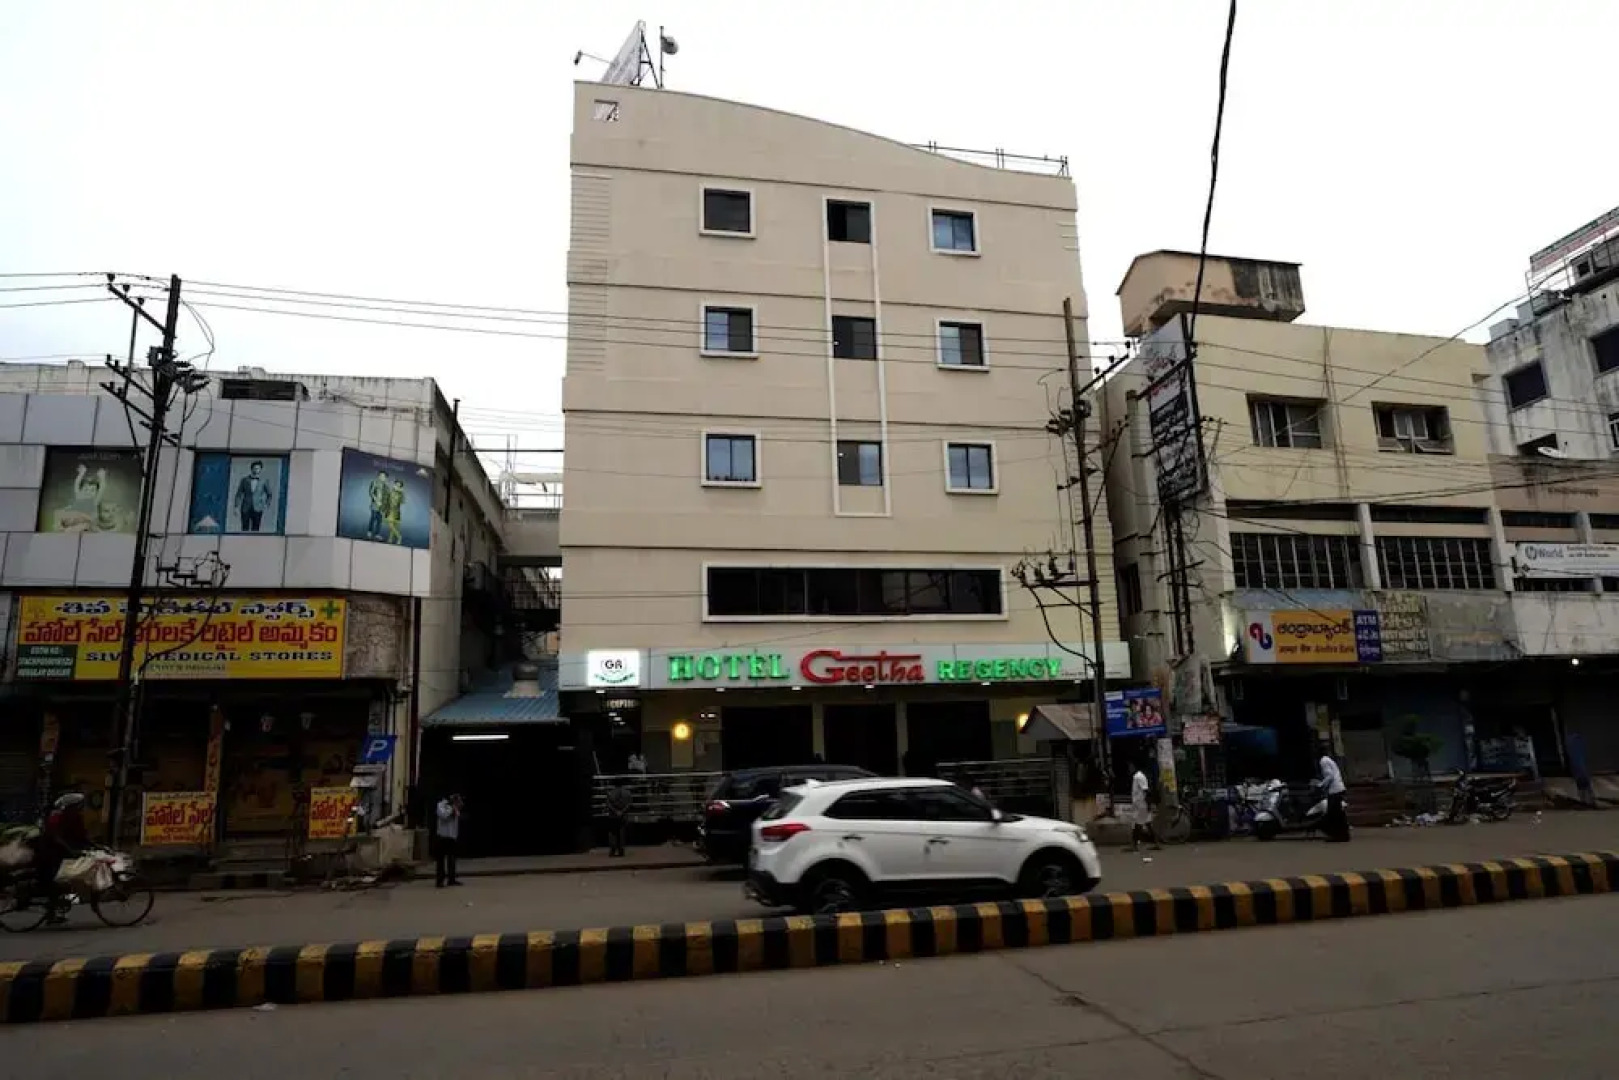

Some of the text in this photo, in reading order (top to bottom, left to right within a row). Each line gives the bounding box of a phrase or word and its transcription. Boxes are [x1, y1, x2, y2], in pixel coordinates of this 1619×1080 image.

[1356, 614, 1377, 625] ATM
[86, 651, 133, 662] SIV
[148, 651, 241, 662] MEDICAL
[250, 651, 333, 662] STORES
[604, 659, 623, 670] GR
[668, 648, 1063, 685] HOTEL Geetha REGENCY
[366, 739, 388, 759] P
